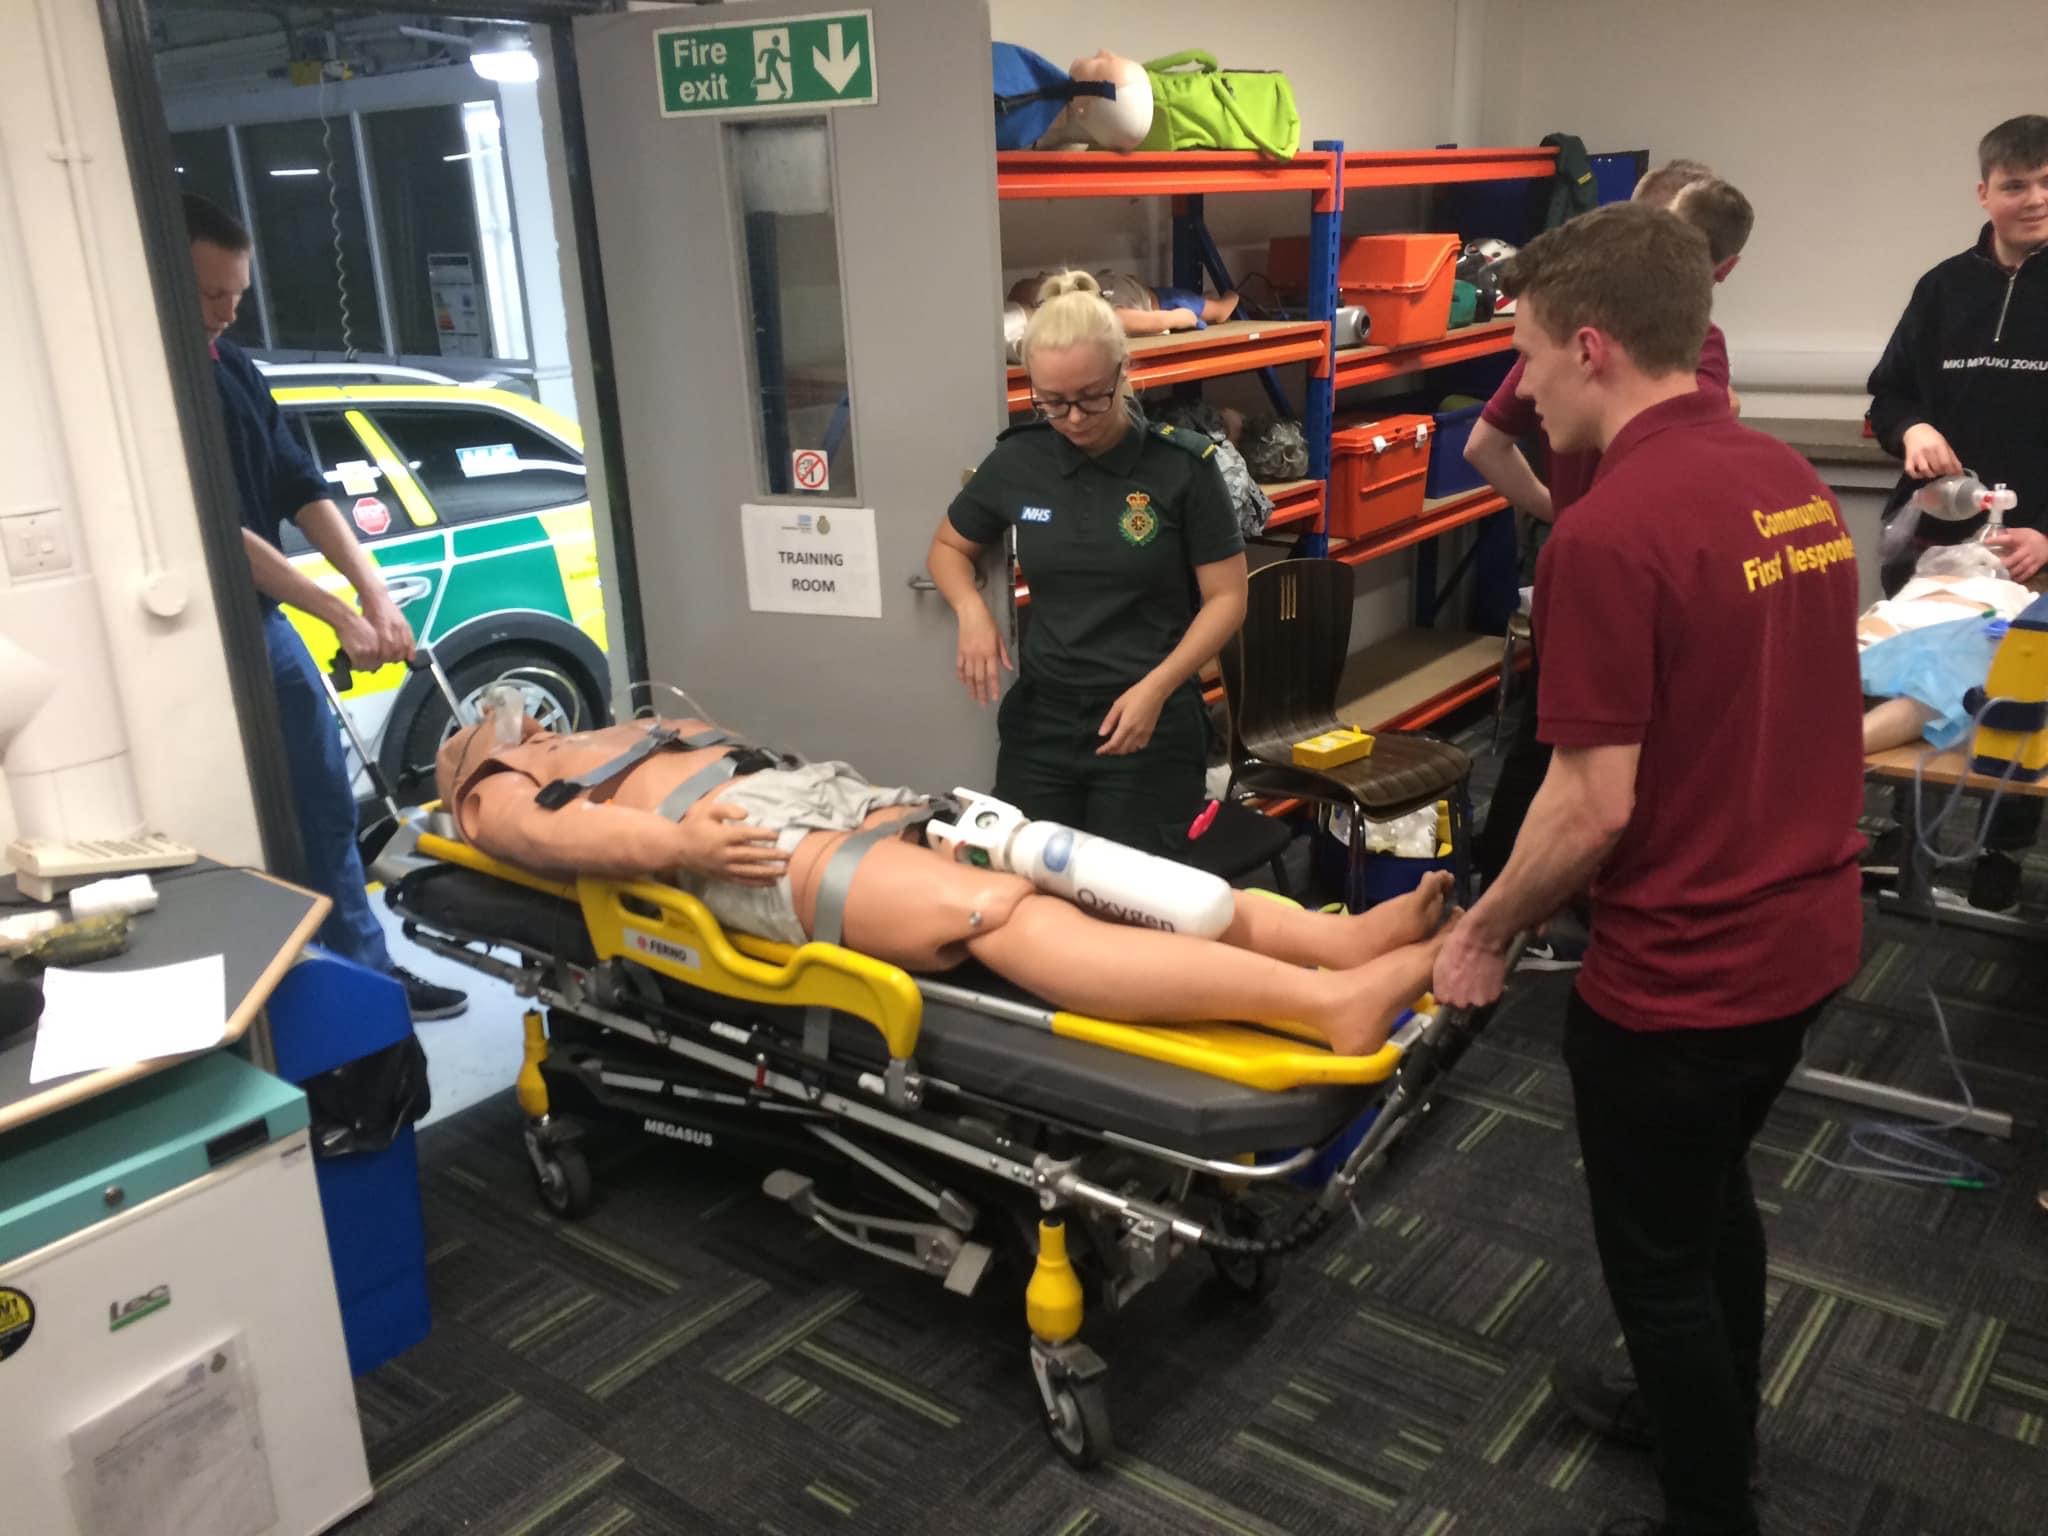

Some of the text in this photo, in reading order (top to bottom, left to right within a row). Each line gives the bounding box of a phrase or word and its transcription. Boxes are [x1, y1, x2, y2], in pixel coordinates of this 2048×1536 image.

[673, 39, 728, 68] Fire
[679, 73, 729, 103] exit
[1021, 506, 1052, 523] NHS
[1752, 494, 1838, 539] Community
[778, 551, 844, 567] TRAINING
[1743, 551, 1783, 592] First
[791, 578, 836, 593] ROOM
[644, 1117, 713, 1147] MEGASUS
